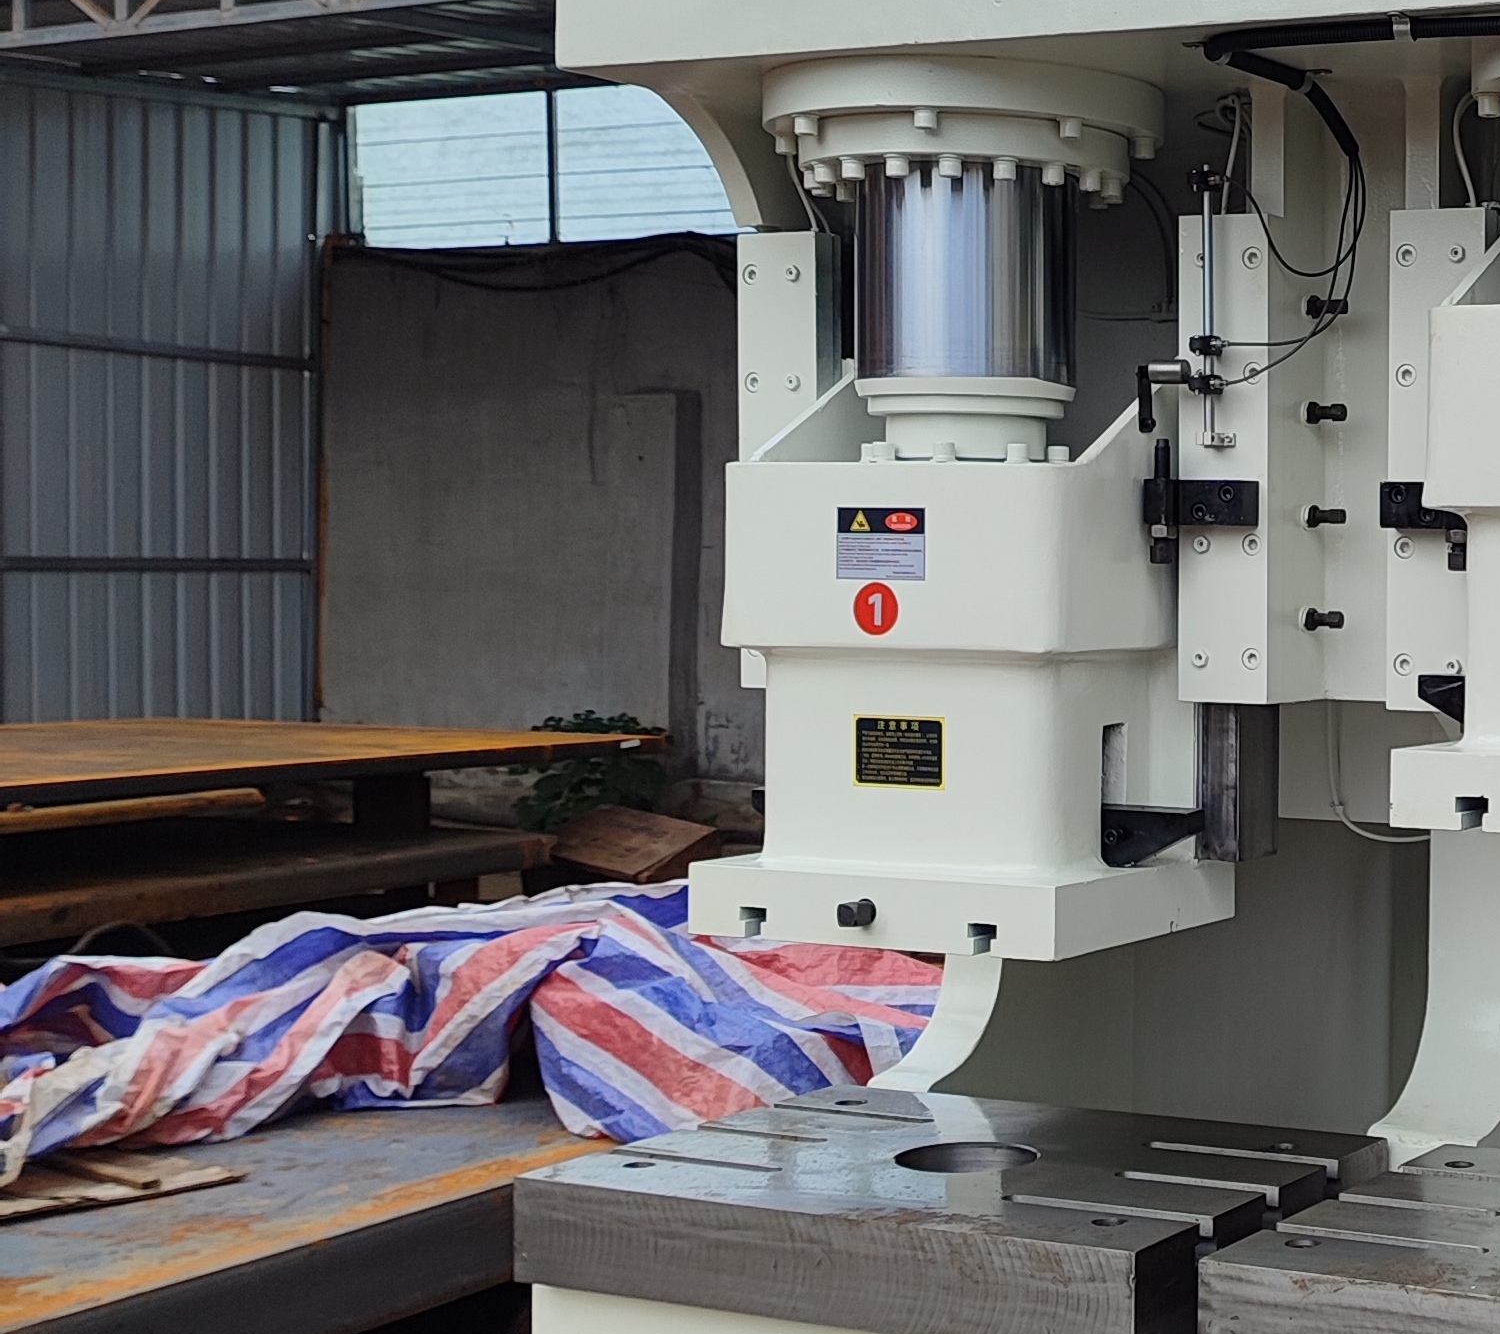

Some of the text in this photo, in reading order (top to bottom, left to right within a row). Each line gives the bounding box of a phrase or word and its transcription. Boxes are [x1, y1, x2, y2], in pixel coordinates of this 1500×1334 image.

[867, 592, 883, 627] 1
[876, 720, 920, 731] 注意事项
